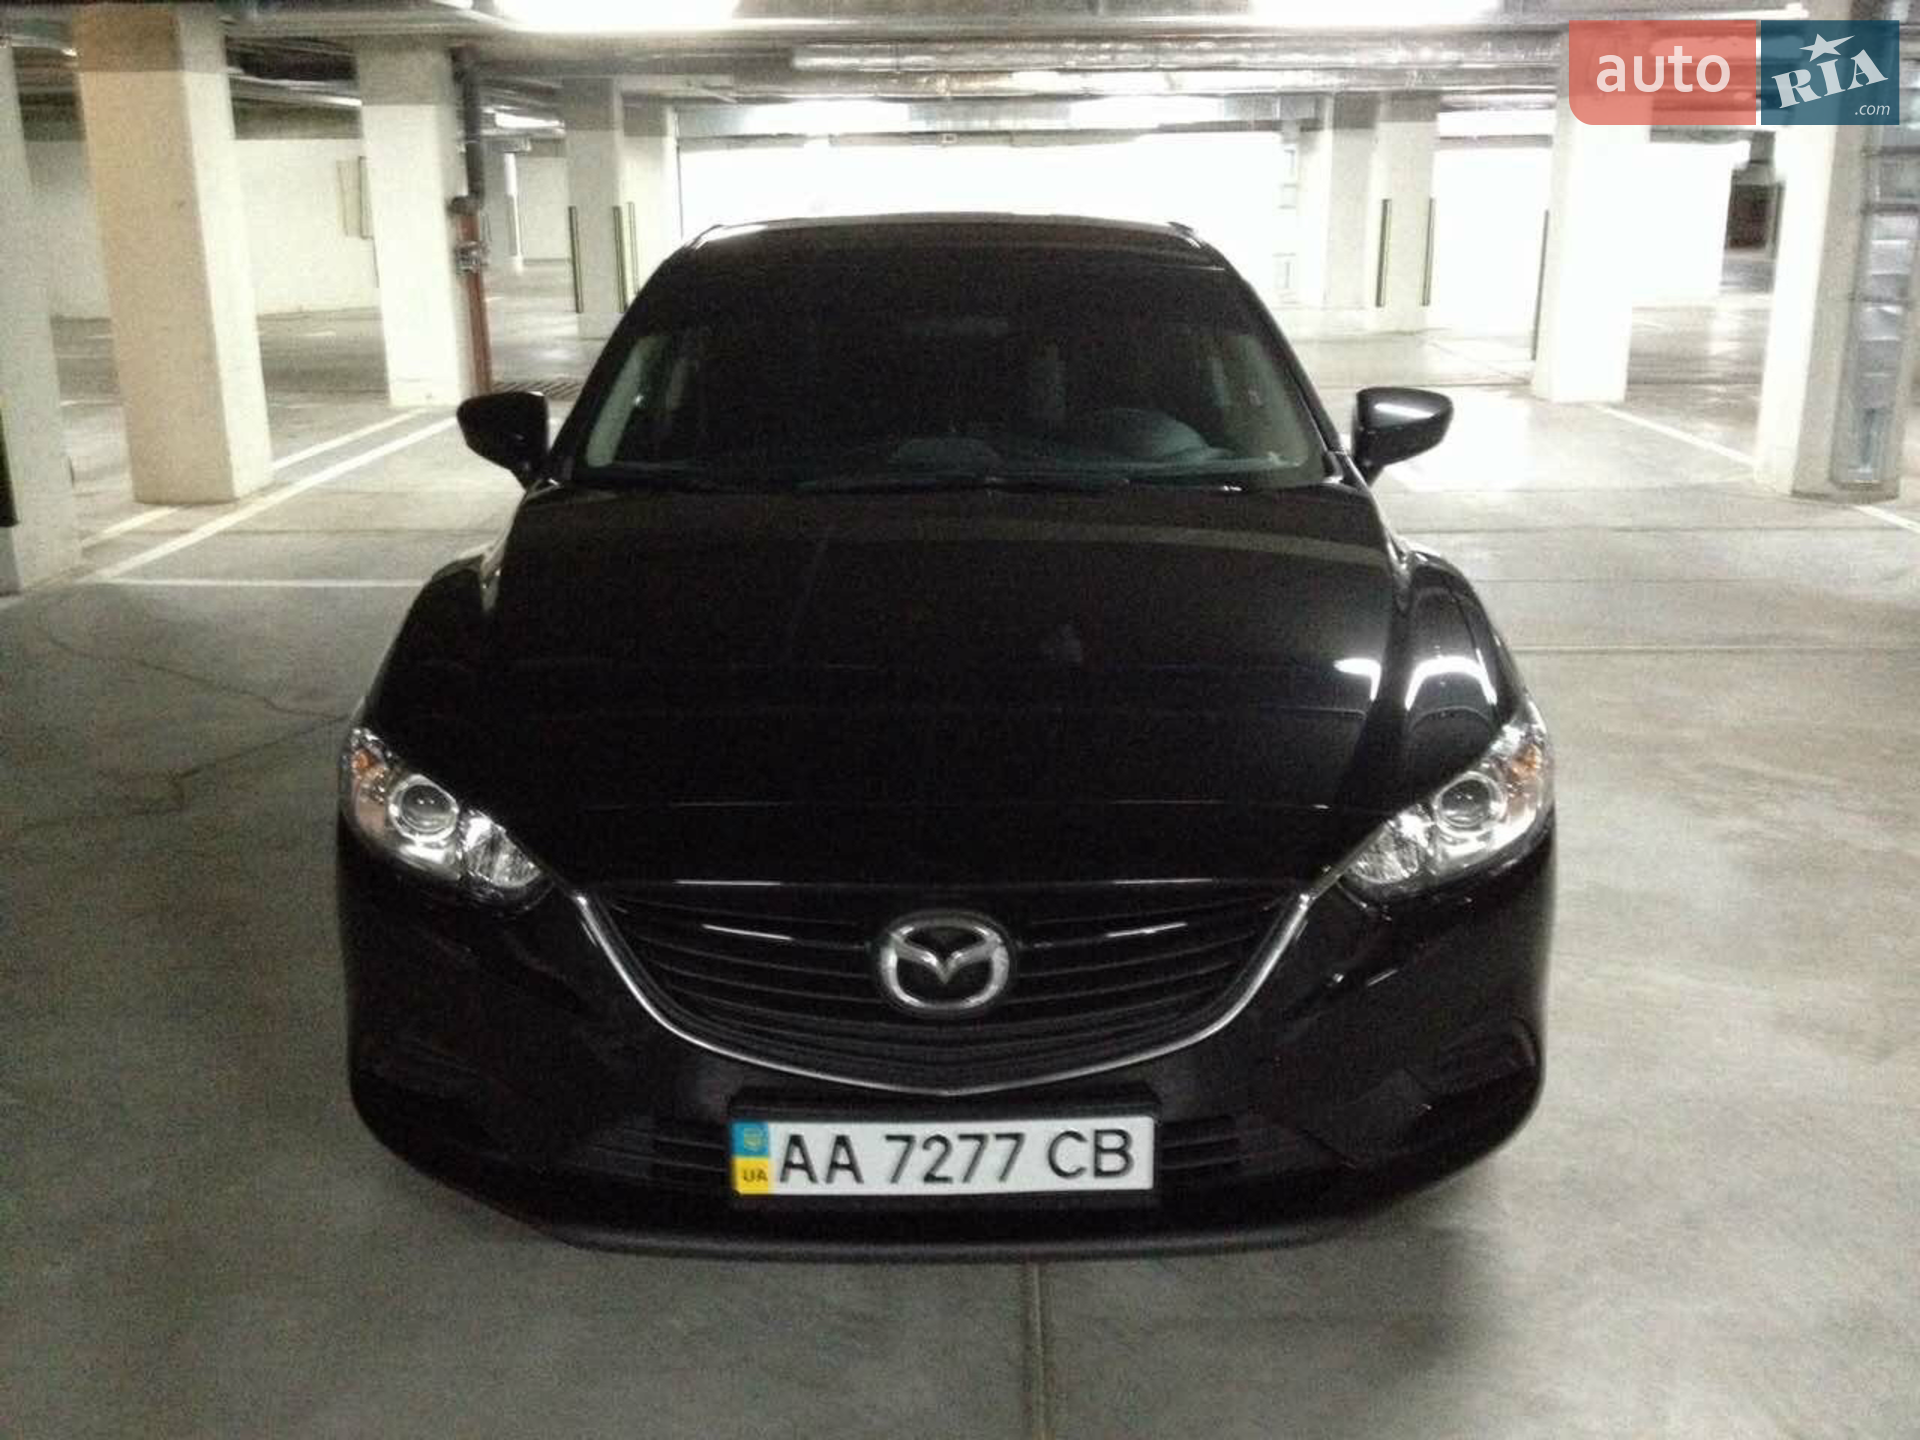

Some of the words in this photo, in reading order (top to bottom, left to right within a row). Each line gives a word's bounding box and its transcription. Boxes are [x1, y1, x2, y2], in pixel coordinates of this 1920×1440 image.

[779, 1134, 864, 1184] AA
[884, 1132, 1025, 1184] 7277
[1047, 1129, 1134, 1179] CB
[742, 1169, 768, 1182] UA
